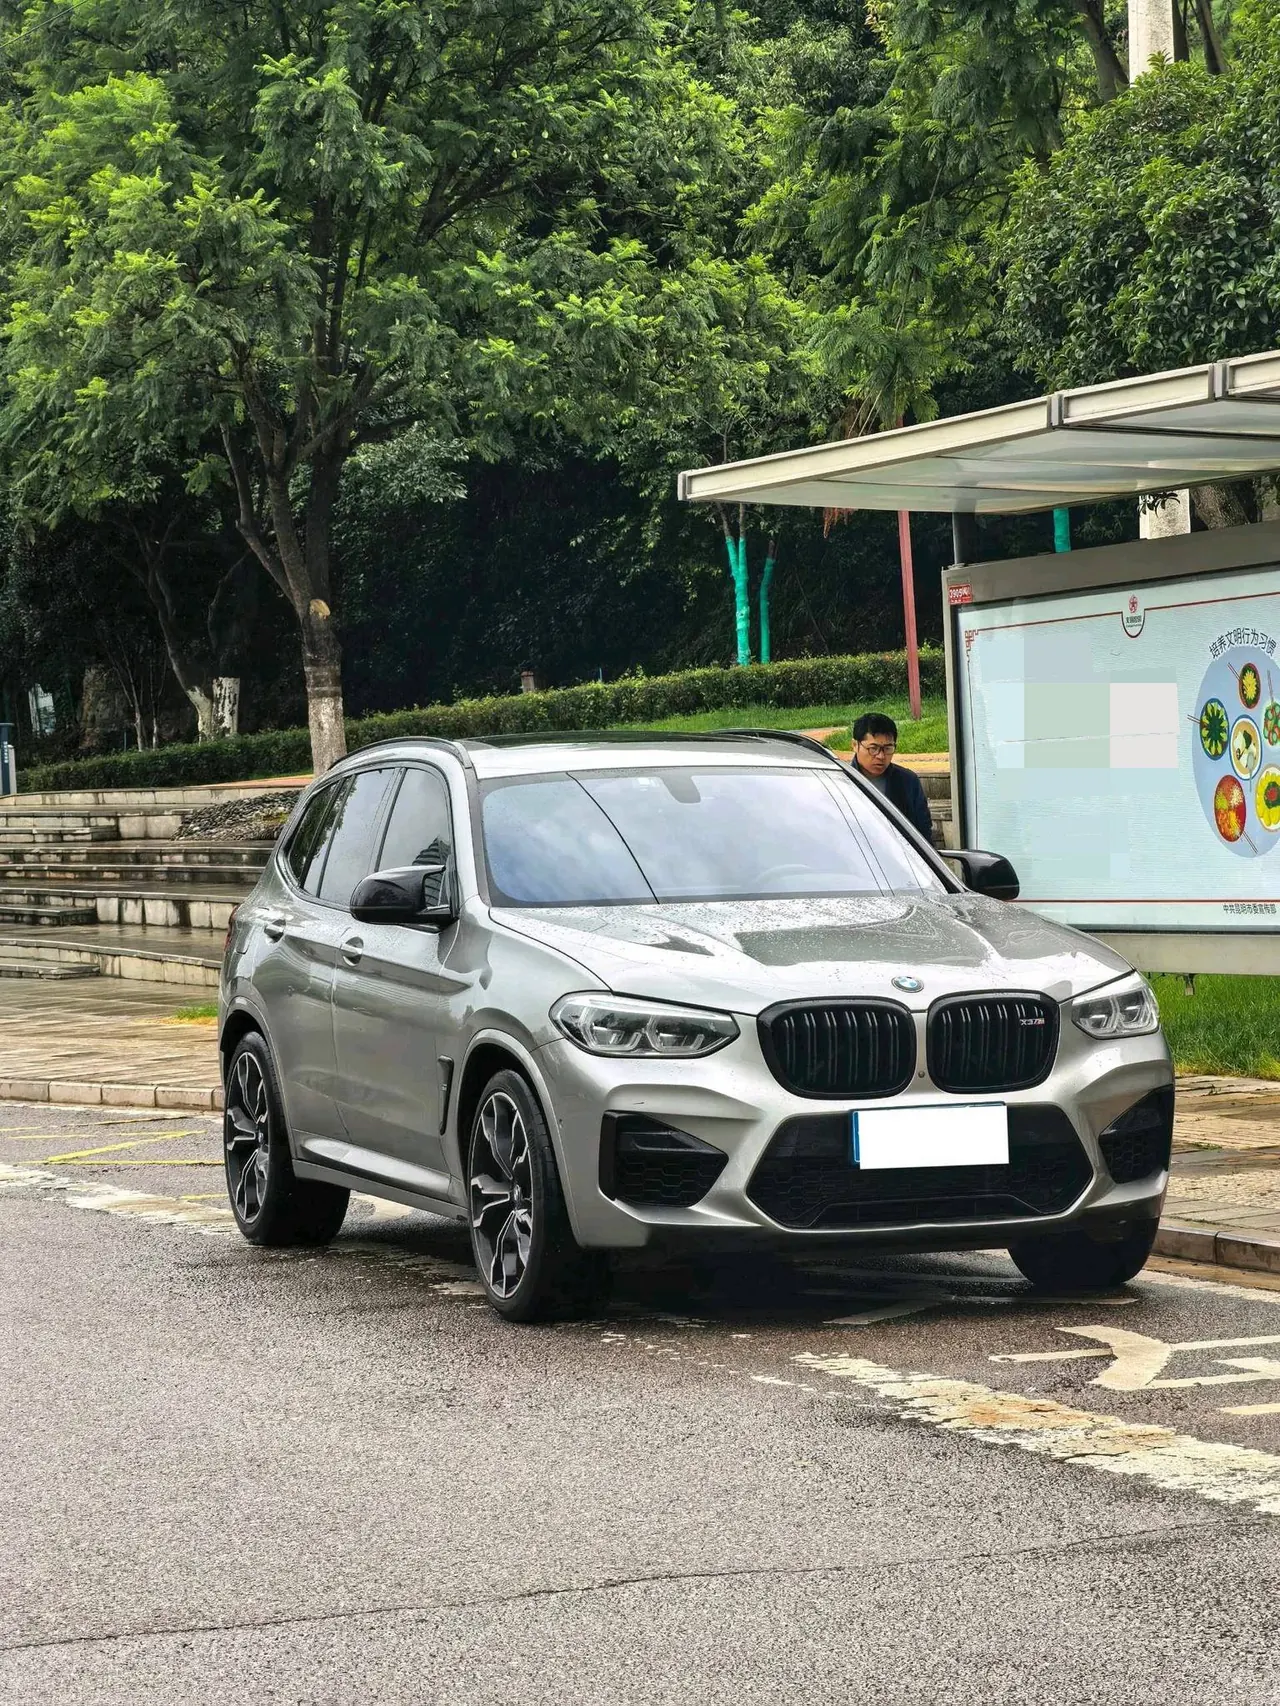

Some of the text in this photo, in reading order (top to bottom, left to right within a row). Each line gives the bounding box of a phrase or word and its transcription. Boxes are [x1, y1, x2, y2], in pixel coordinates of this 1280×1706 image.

[1208, 627, 1277, 659] 培养文明行为习惯
